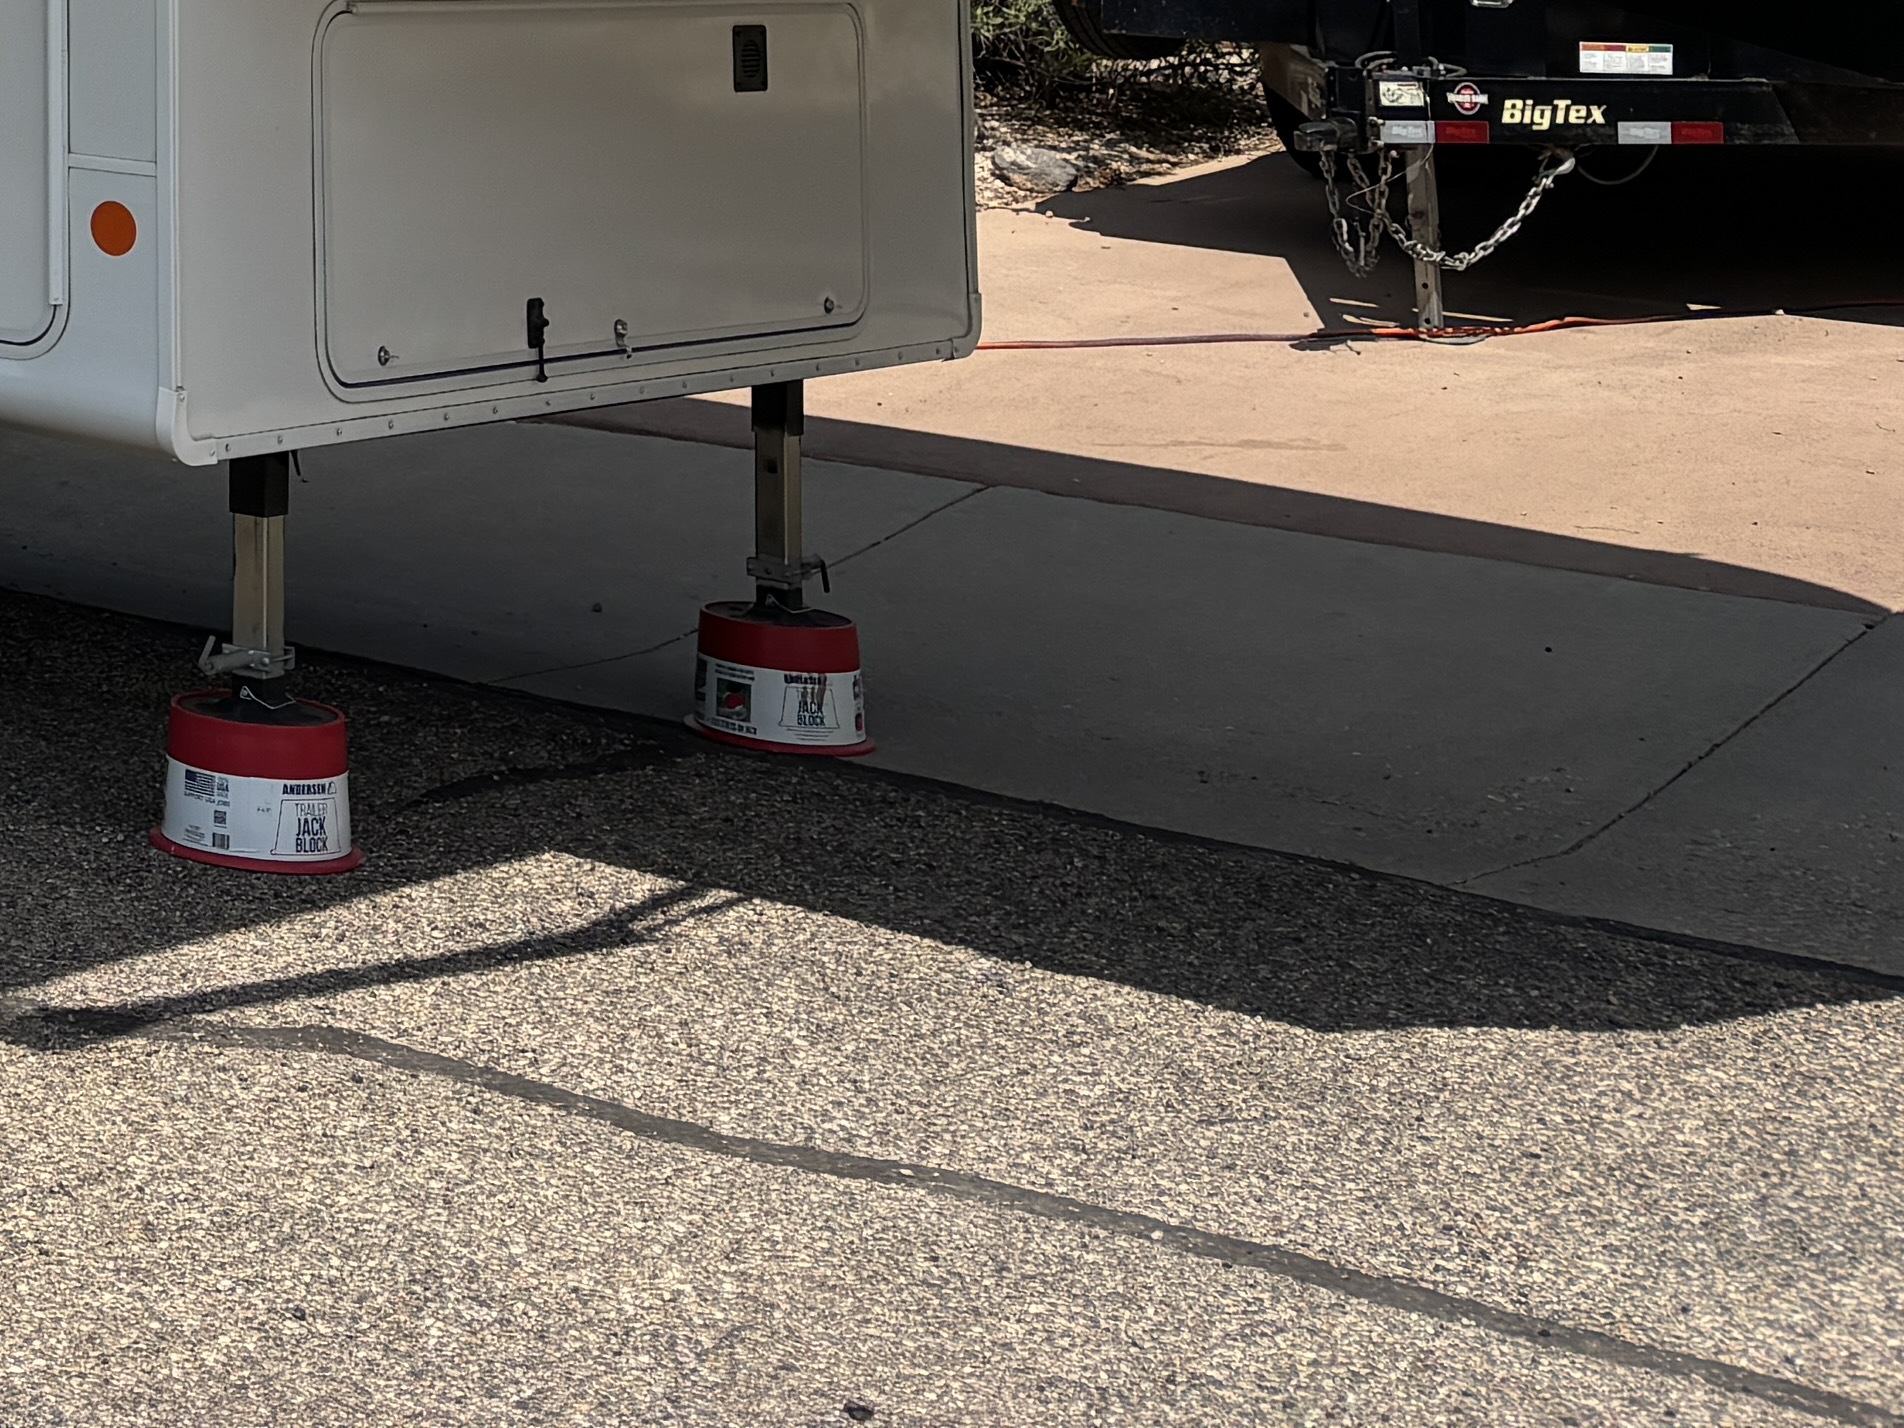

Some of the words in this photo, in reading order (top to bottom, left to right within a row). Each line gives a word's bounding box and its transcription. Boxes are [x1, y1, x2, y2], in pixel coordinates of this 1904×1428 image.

[1501, 99, 1606, 131] BigTex
[797, 714, 826, 726] BLOCK
[282, 783, 326, 795] ANDERSEN
[295, 802, 328, 816] TRAILER
[295, 816, 326, 836] JACK
[295, 836, 329, 853] BLOCK
